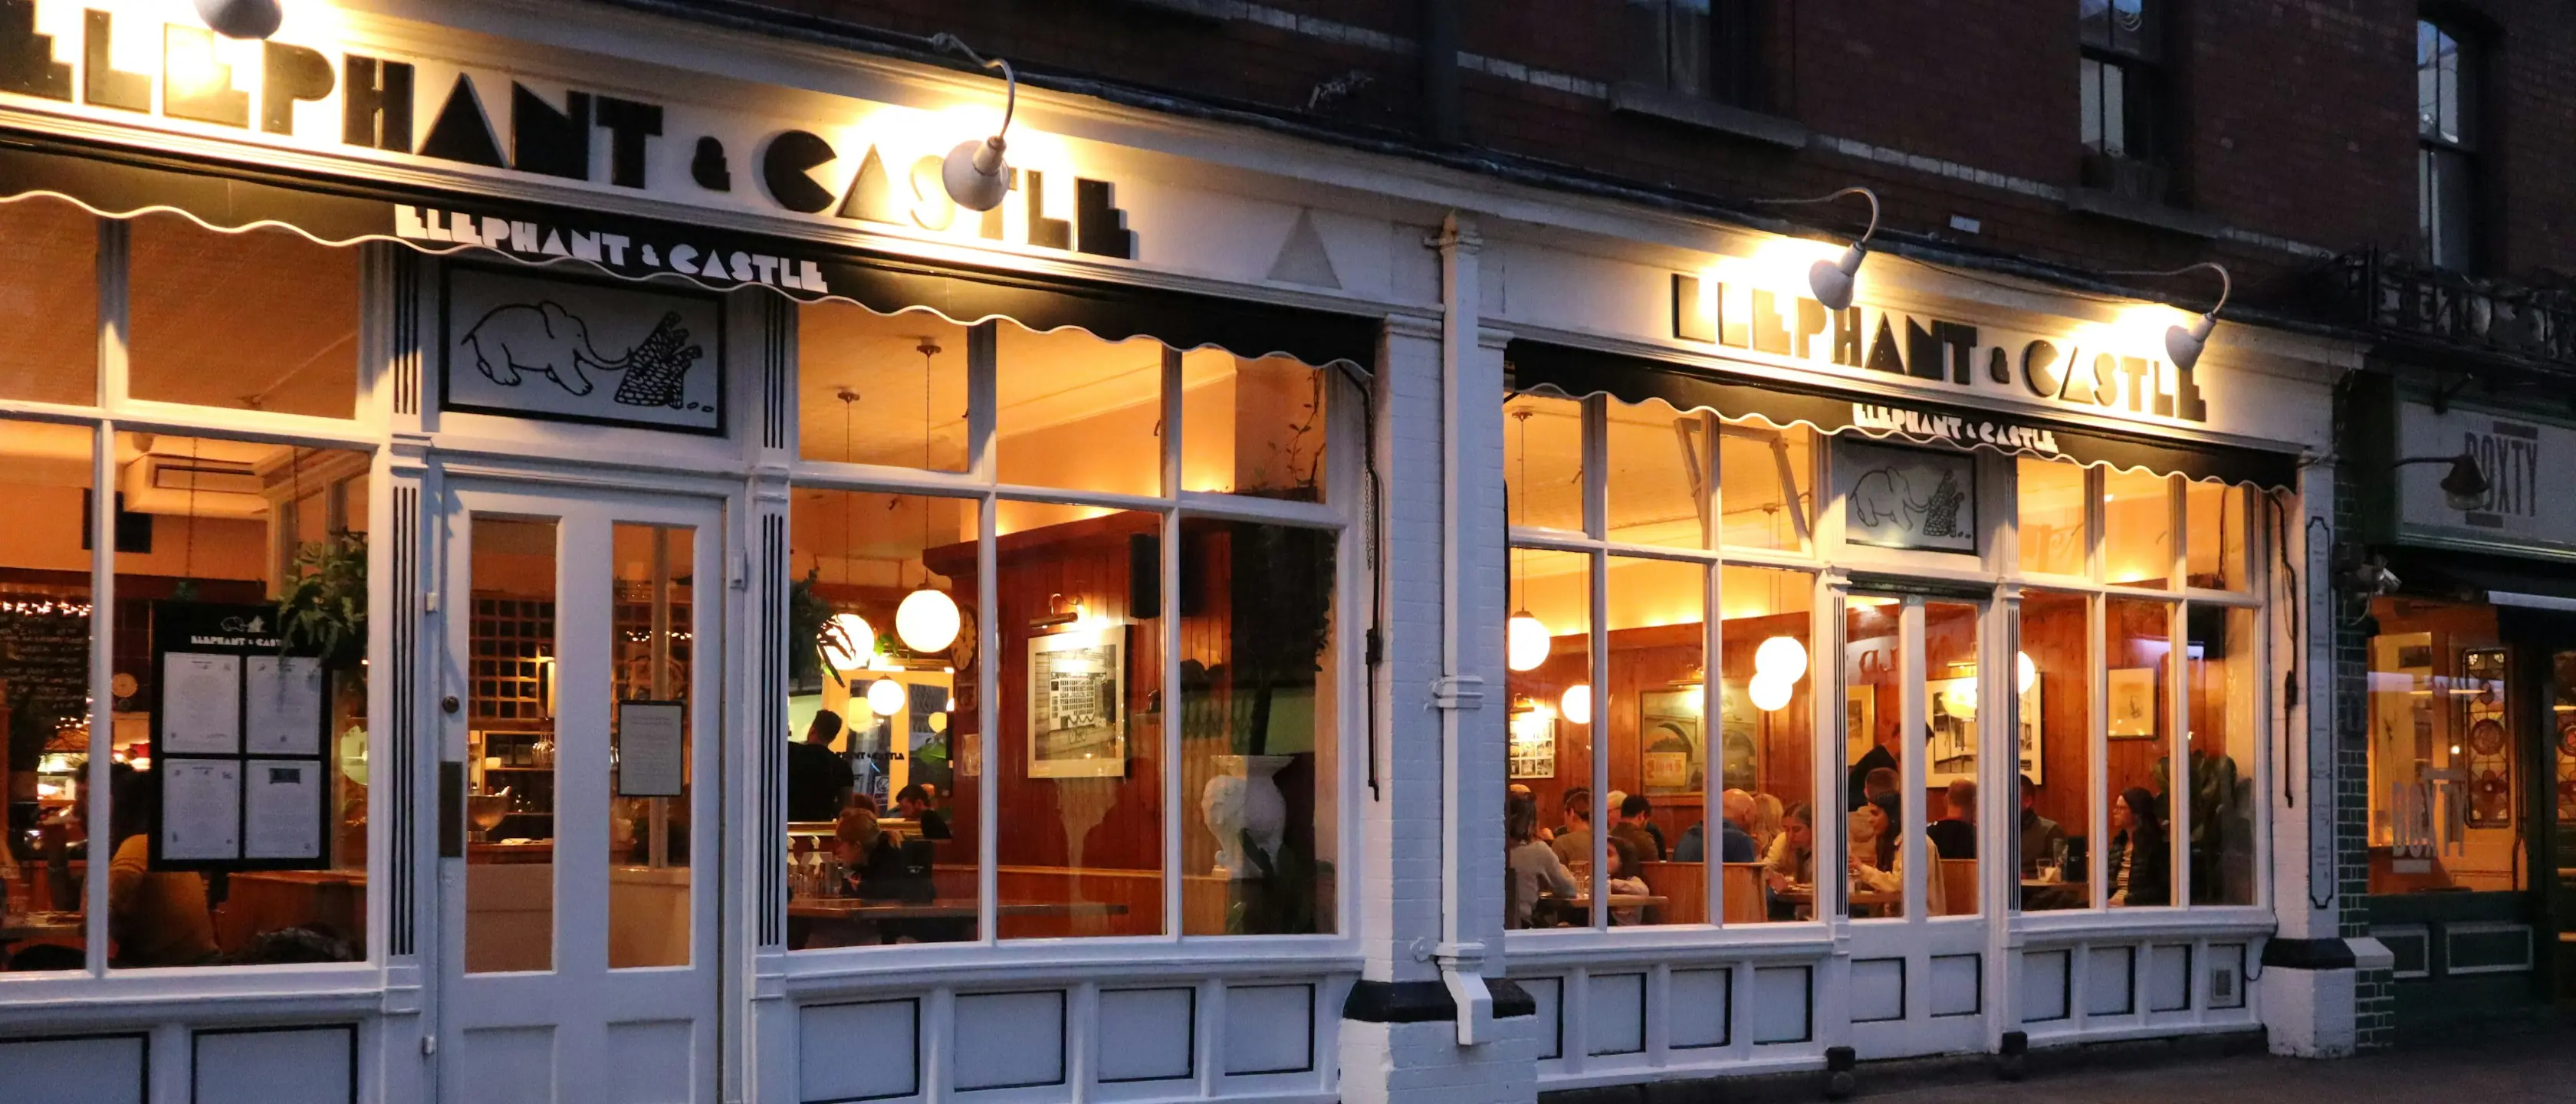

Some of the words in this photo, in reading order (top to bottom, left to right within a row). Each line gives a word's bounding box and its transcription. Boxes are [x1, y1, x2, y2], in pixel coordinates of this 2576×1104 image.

[0, 0, 662, 189] ELEPHANT
[692, 136, 731, 192] &
[395, 204, 629, 267] ELEPHANT
[642, 244, 660, 267] &
[669, 244, 828, 294] CASTLE
[1990, 347, 2010, 384] &
[2021, 340, 2206, 423] CASTLE
[1852, 402, 1962, 439] ELEPHANT
[1967, 422, 1976, 439] &
[1980, 422, 2058, 454] CASTLE
[191, 636, 245, 646] ELEPHANT
[255, 638, 294, 647] CAST
